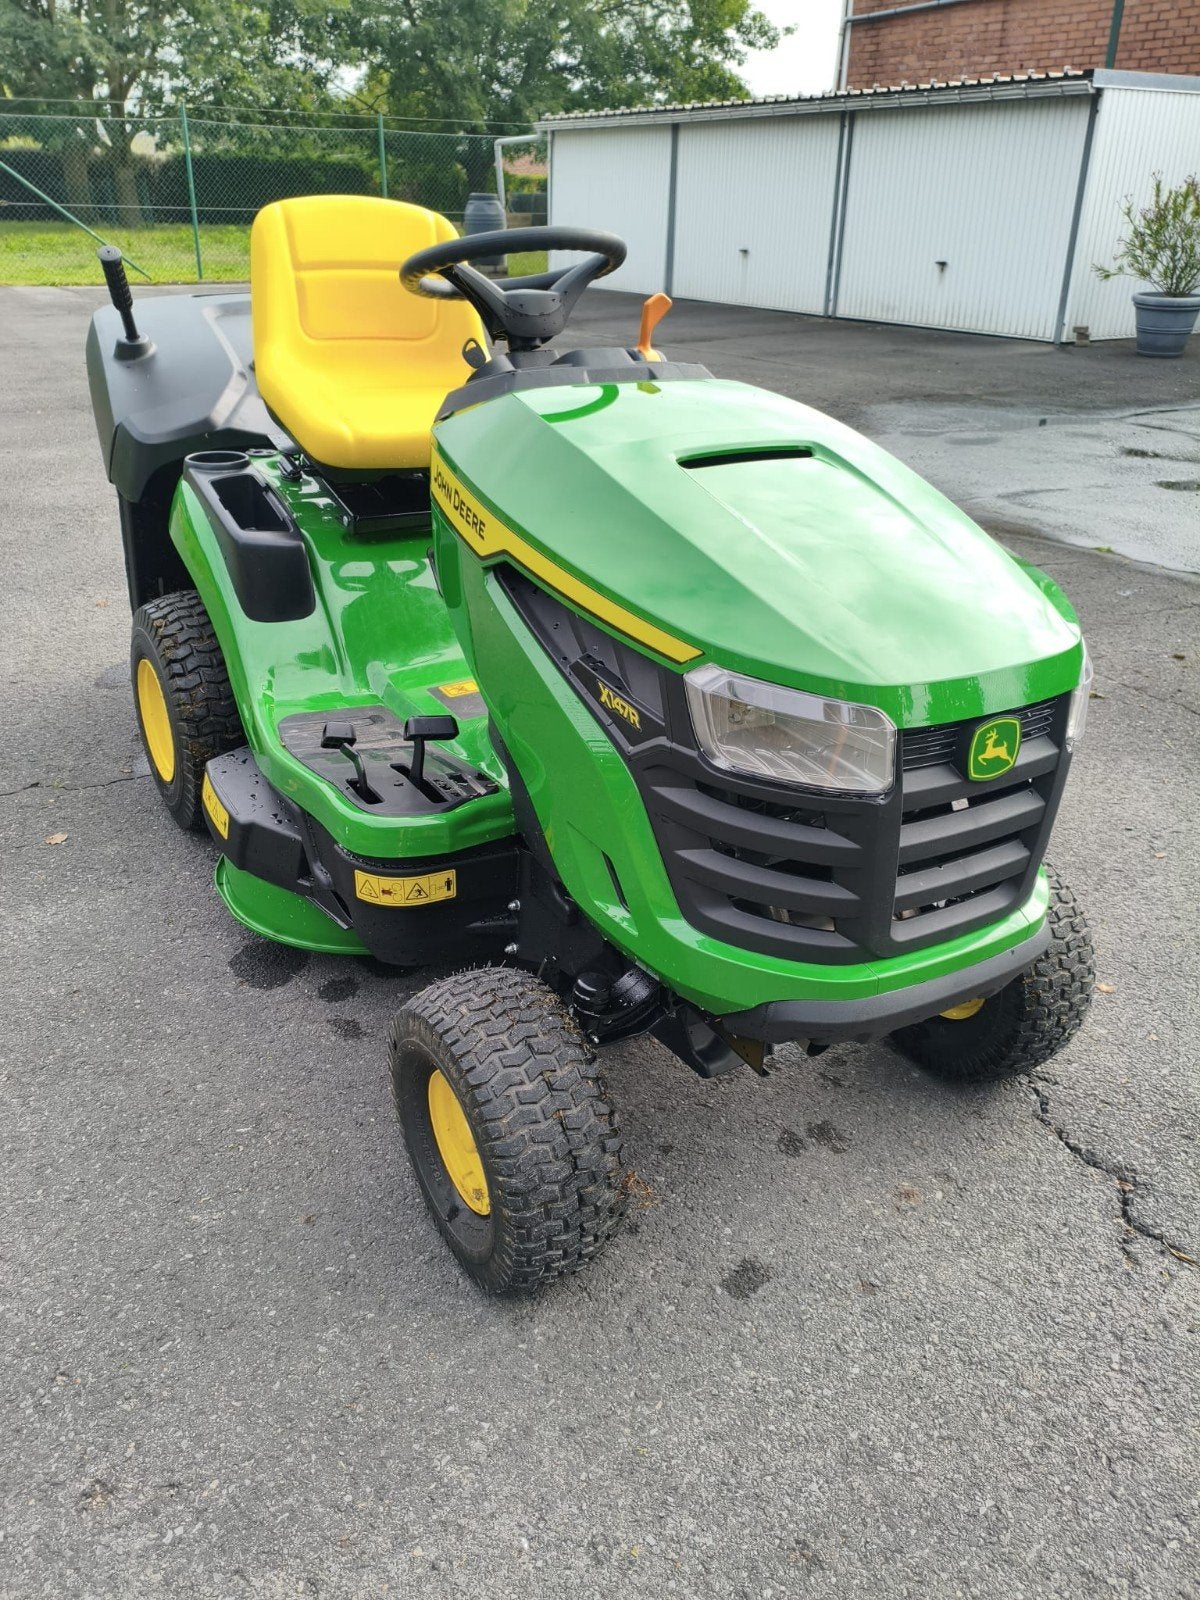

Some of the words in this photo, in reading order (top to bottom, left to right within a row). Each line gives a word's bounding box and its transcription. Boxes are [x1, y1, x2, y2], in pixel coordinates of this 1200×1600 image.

[434, 464, 453, 504] JOHN
[453, 488, 486, 541] DEERE
[597, 679, 641, 730] X147R
